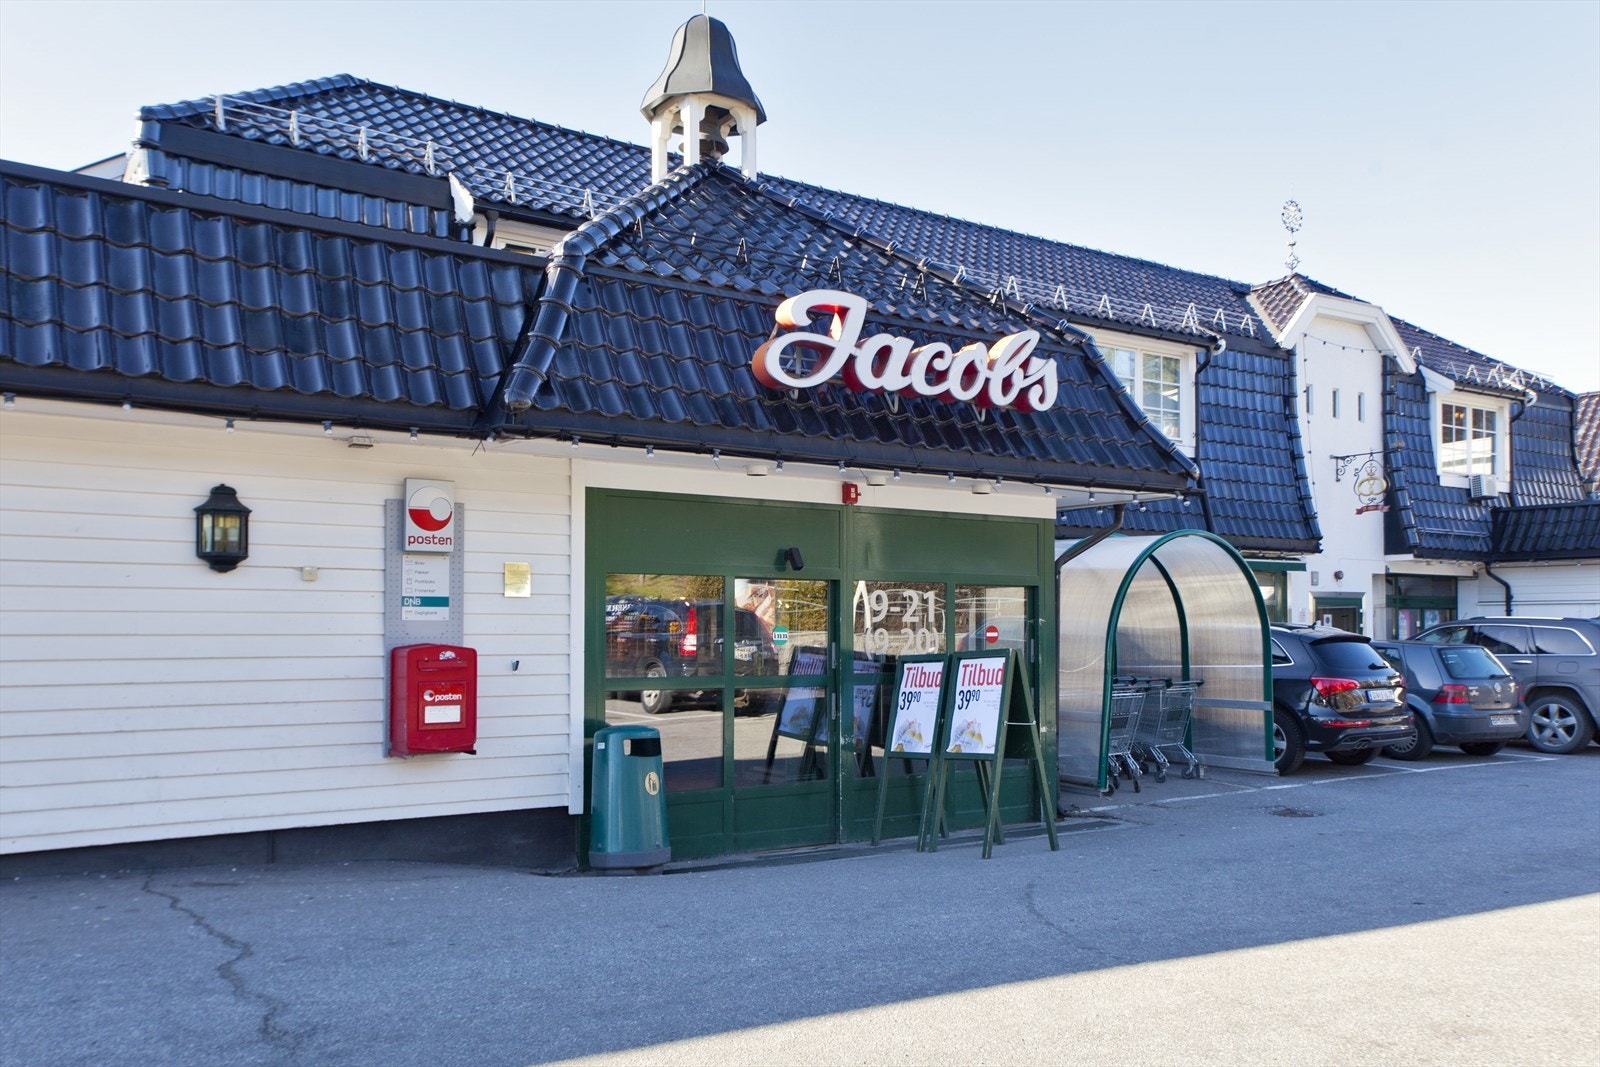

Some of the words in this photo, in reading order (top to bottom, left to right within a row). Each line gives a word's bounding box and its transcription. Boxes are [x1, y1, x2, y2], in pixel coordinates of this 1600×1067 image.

[753, 289, 1058, 411] Jacobs
[407, 534, 453, 546] posten
[404, 597, 421, 606] DNB
[870, 589, 935, 623] 9-21
[773, 632, 788, 640] inn
[961, 662, 1006, 686] Tilbud
[435, 693, 463, 702] posten
